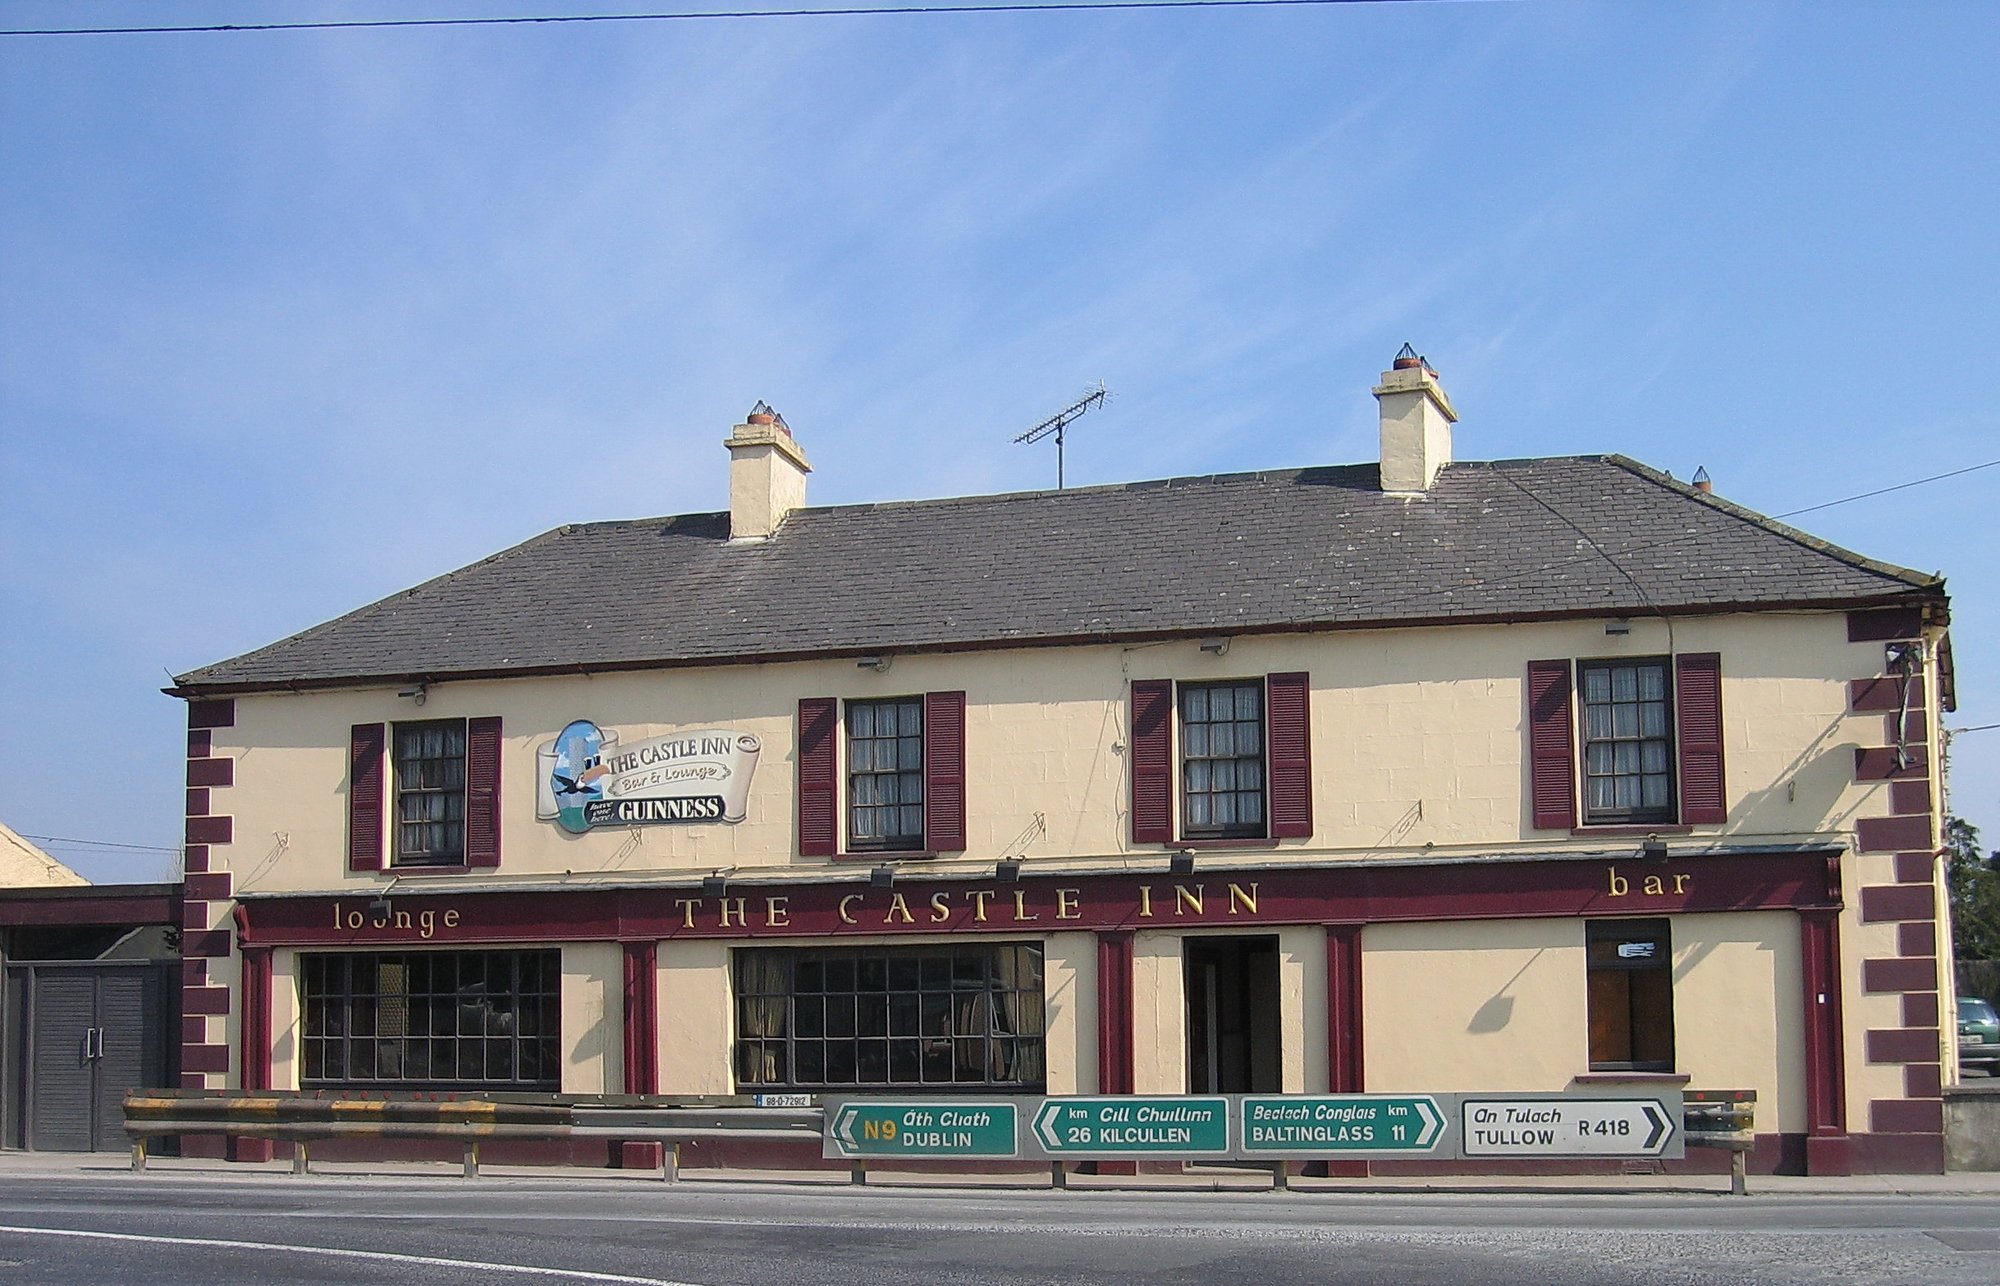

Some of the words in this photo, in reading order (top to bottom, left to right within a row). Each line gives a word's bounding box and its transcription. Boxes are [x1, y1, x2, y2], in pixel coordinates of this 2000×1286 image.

[607, 753, 638, 775] THE
[640, 739, 698, 764] CASTLE
[701, 737, 732, 755] INN
[622, 776, 645, 791] Bar
[650, 773, 662, 784] &
[665, 766, 717, 781] Lounge
[618, 798, 719, 820] GUINNESS
[1608, 866, 1690, 896] bar
[675, 896, 789, 929] THE
[839, 888, 1082, 924] CASTLE
[1139, 882, 1259, 917] INN
[940, 1111, 991, 1126] Cliath
[1069, 1107, 1088, 1119] km
[1100, 1107, 1129, 1122] Cill
[1137, 1107, 1212, 1122] Chuillinn
[1253, 1105, 1310, 1120] Bealach
[1315, 1104, 1376, 1122] Conglais
[1388, 1105, 1408, 1116] km
[1474, 1108, 1497, 1123] An
[1505, 1108, 1562, 1123] Tulach
[864, 1120, 897, 1140] N9
[1068, 1127, 1091, 1143] 26
[1100, 1127, 1191, 1143] KILCULLEN
[1253, 1126, 1374, 1141] BALTINGLASS
[1392, 1125, 1406, 1141] 11
[1475, 1130, 1554, 1145] TULLOW
[903, 1132, 971, 1146] DUBLIN
